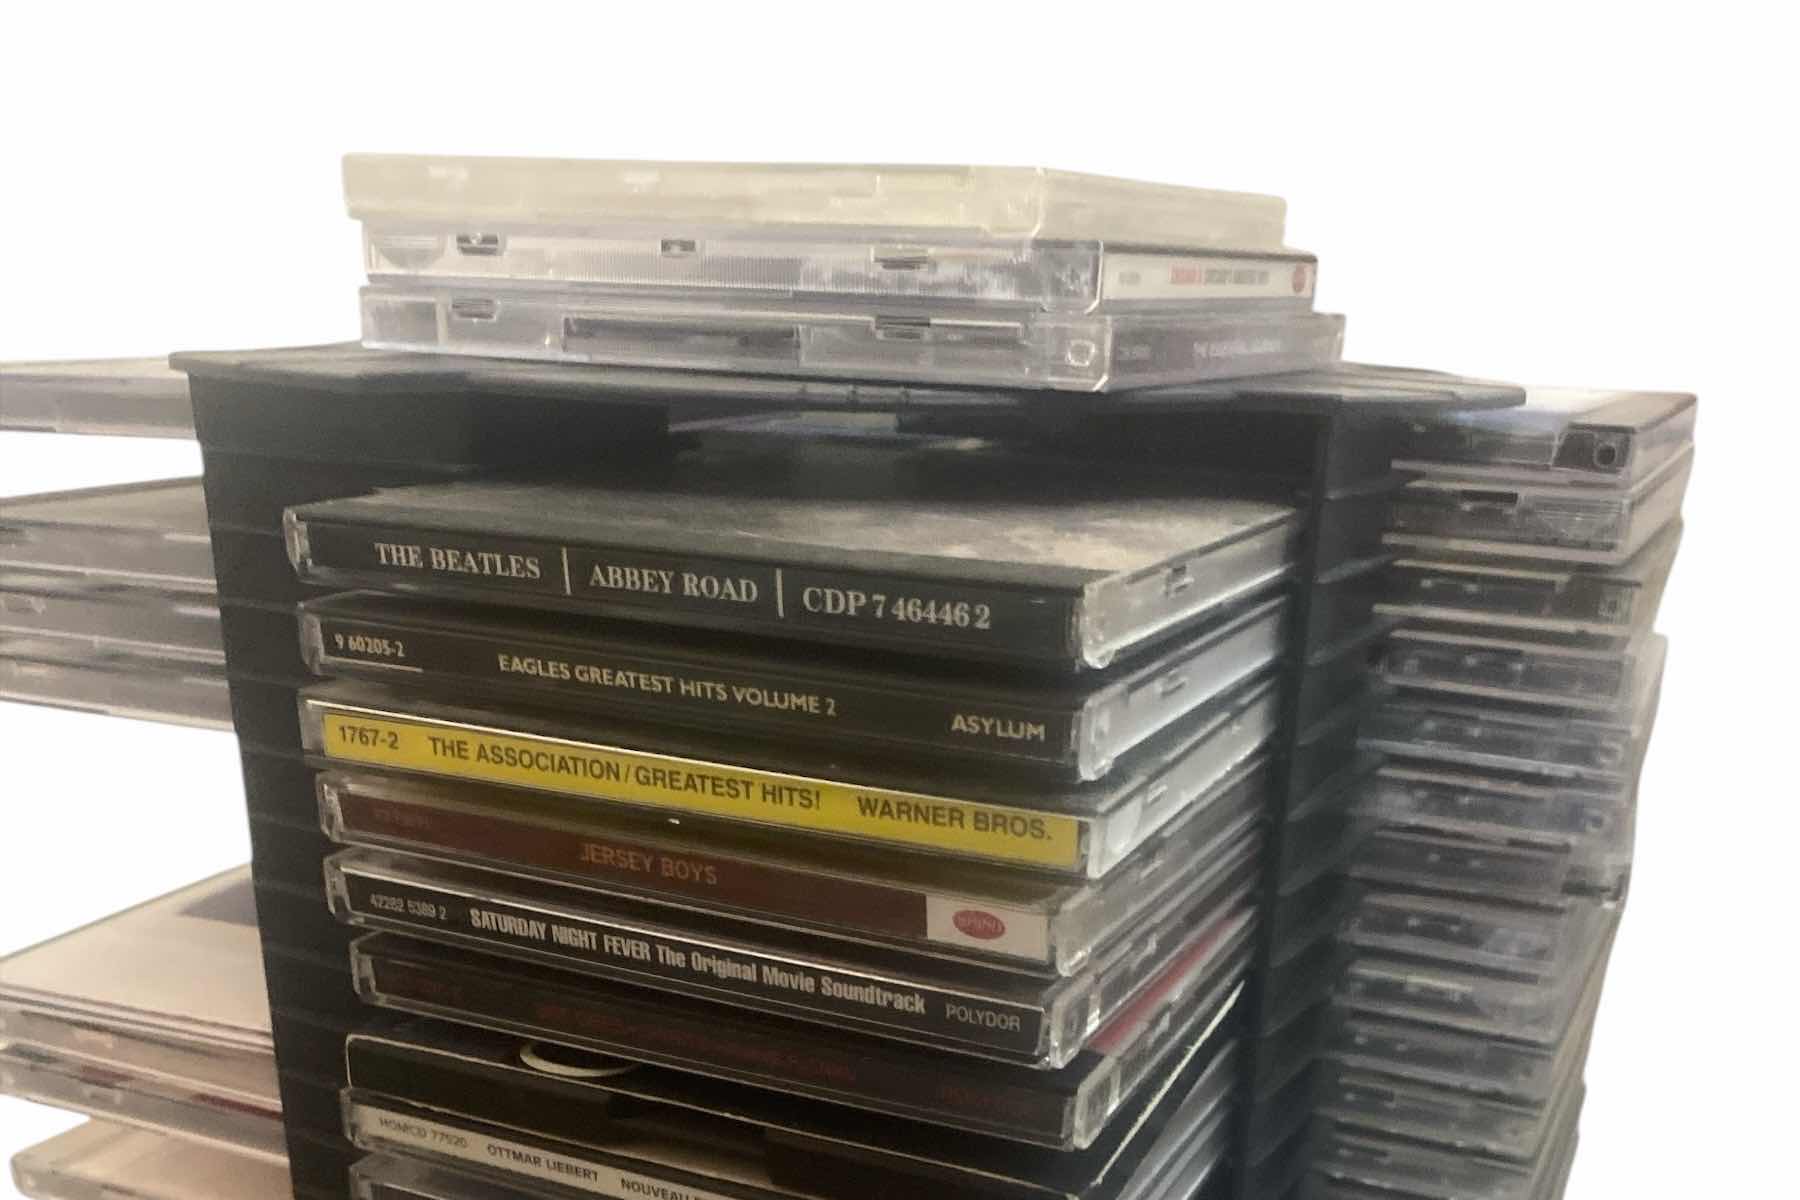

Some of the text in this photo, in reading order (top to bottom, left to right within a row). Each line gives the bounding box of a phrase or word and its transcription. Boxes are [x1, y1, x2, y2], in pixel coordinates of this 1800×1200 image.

[374, 542, 541, 579] THE BEATLES
[589, 564, 758, 603] ABBEY ROAD
[803, 587, 867, 616] CDP
[498, 653, 837, 717] EAGLES GREATEST HITS VOLUME 2
[951, 713, 1046, 742] ASYLUM
[339, 724, 399, 750] 1767-2
[427, 736, 470, 761] THE
[761, 783, 821, 809] HITS!
[857, 796, 964, 829] WARNER
[974, 810, 1054, 841] BROS.
[580, 844, 718, 885] JERSEY BOYS
[469, 908, 546, 940] SATURDAY
[551, 924, 598, 951] NIGHT
[603, 935, 651, 961] FEVER
[657, 945, 686, 968] The
[691, 951, 757, 984] Original
[762, 965, 815, 994] Movie
[820, 978, 926, 1015] Soundtrack
[945, 1003, 1021, 1033] POLYDOR
[487, 1144, 542, 1168] OTTMAR
[545, 1159, 599, 1183] LIEBERT
